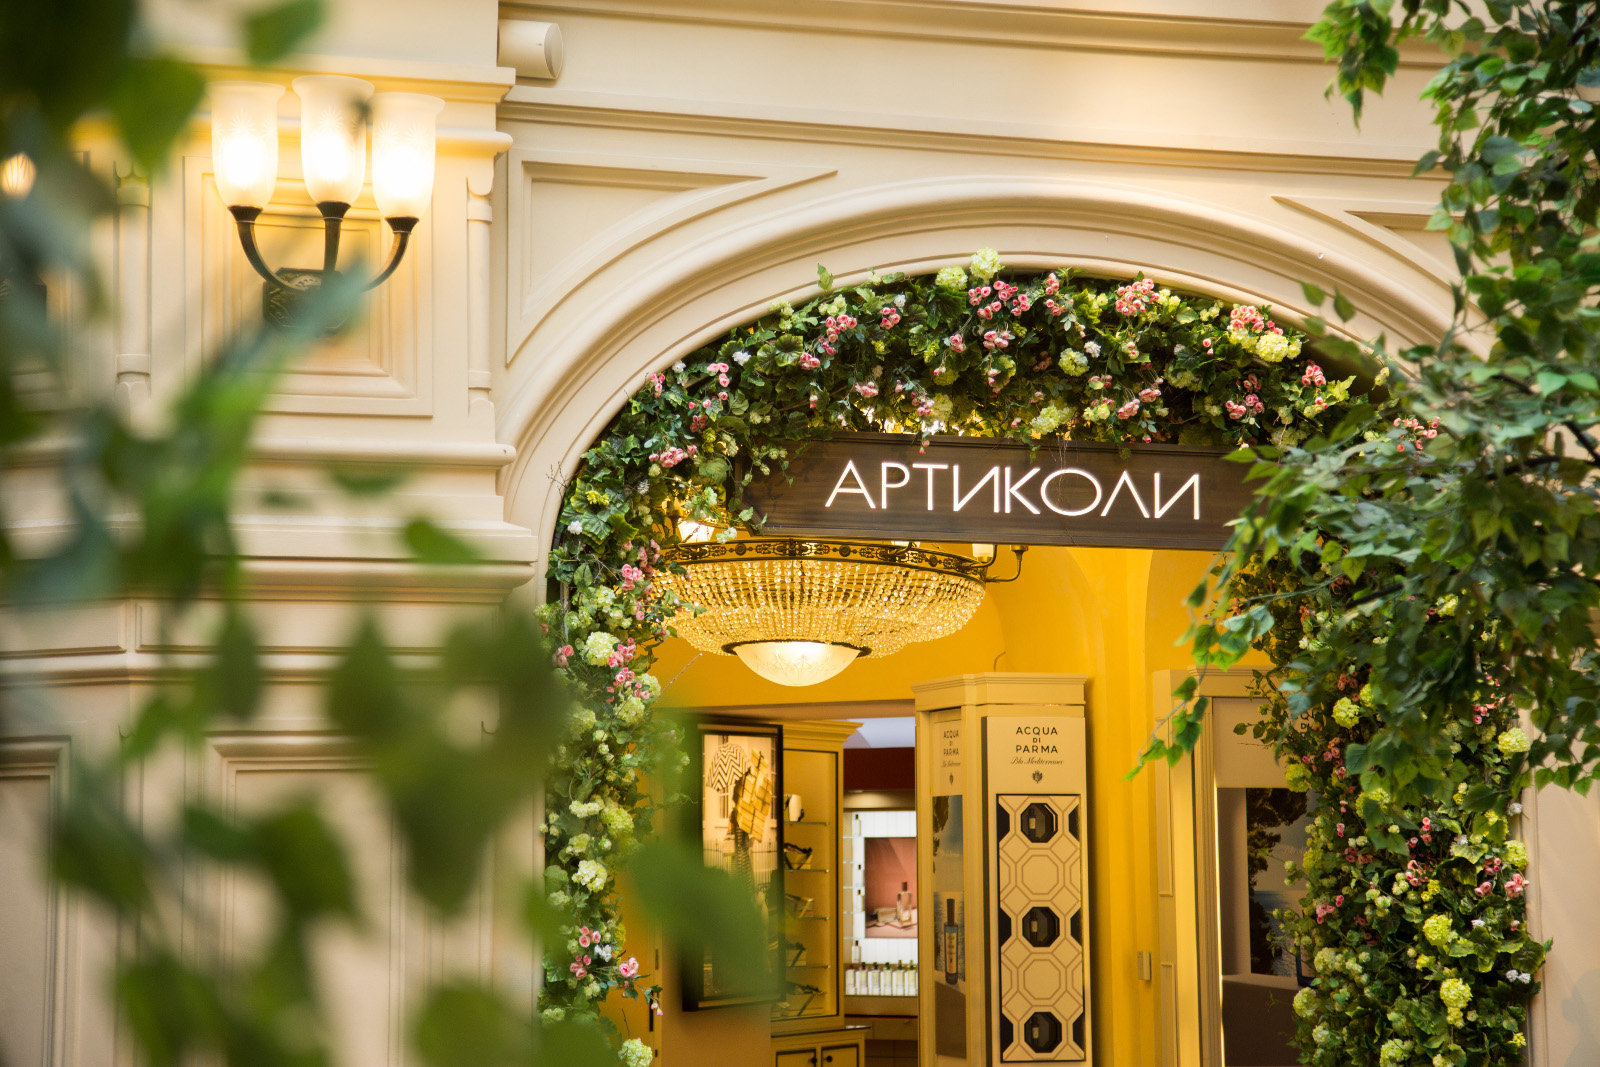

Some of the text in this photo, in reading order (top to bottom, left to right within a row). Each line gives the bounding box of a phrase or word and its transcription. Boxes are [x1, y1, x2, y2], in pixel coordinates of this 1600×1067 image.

[824, 459, 1201, 521] АРТИКОЛИ
[1015, 726, 1059, 736] ACQUA
[1015, 744, 1059, 754] PARMA
